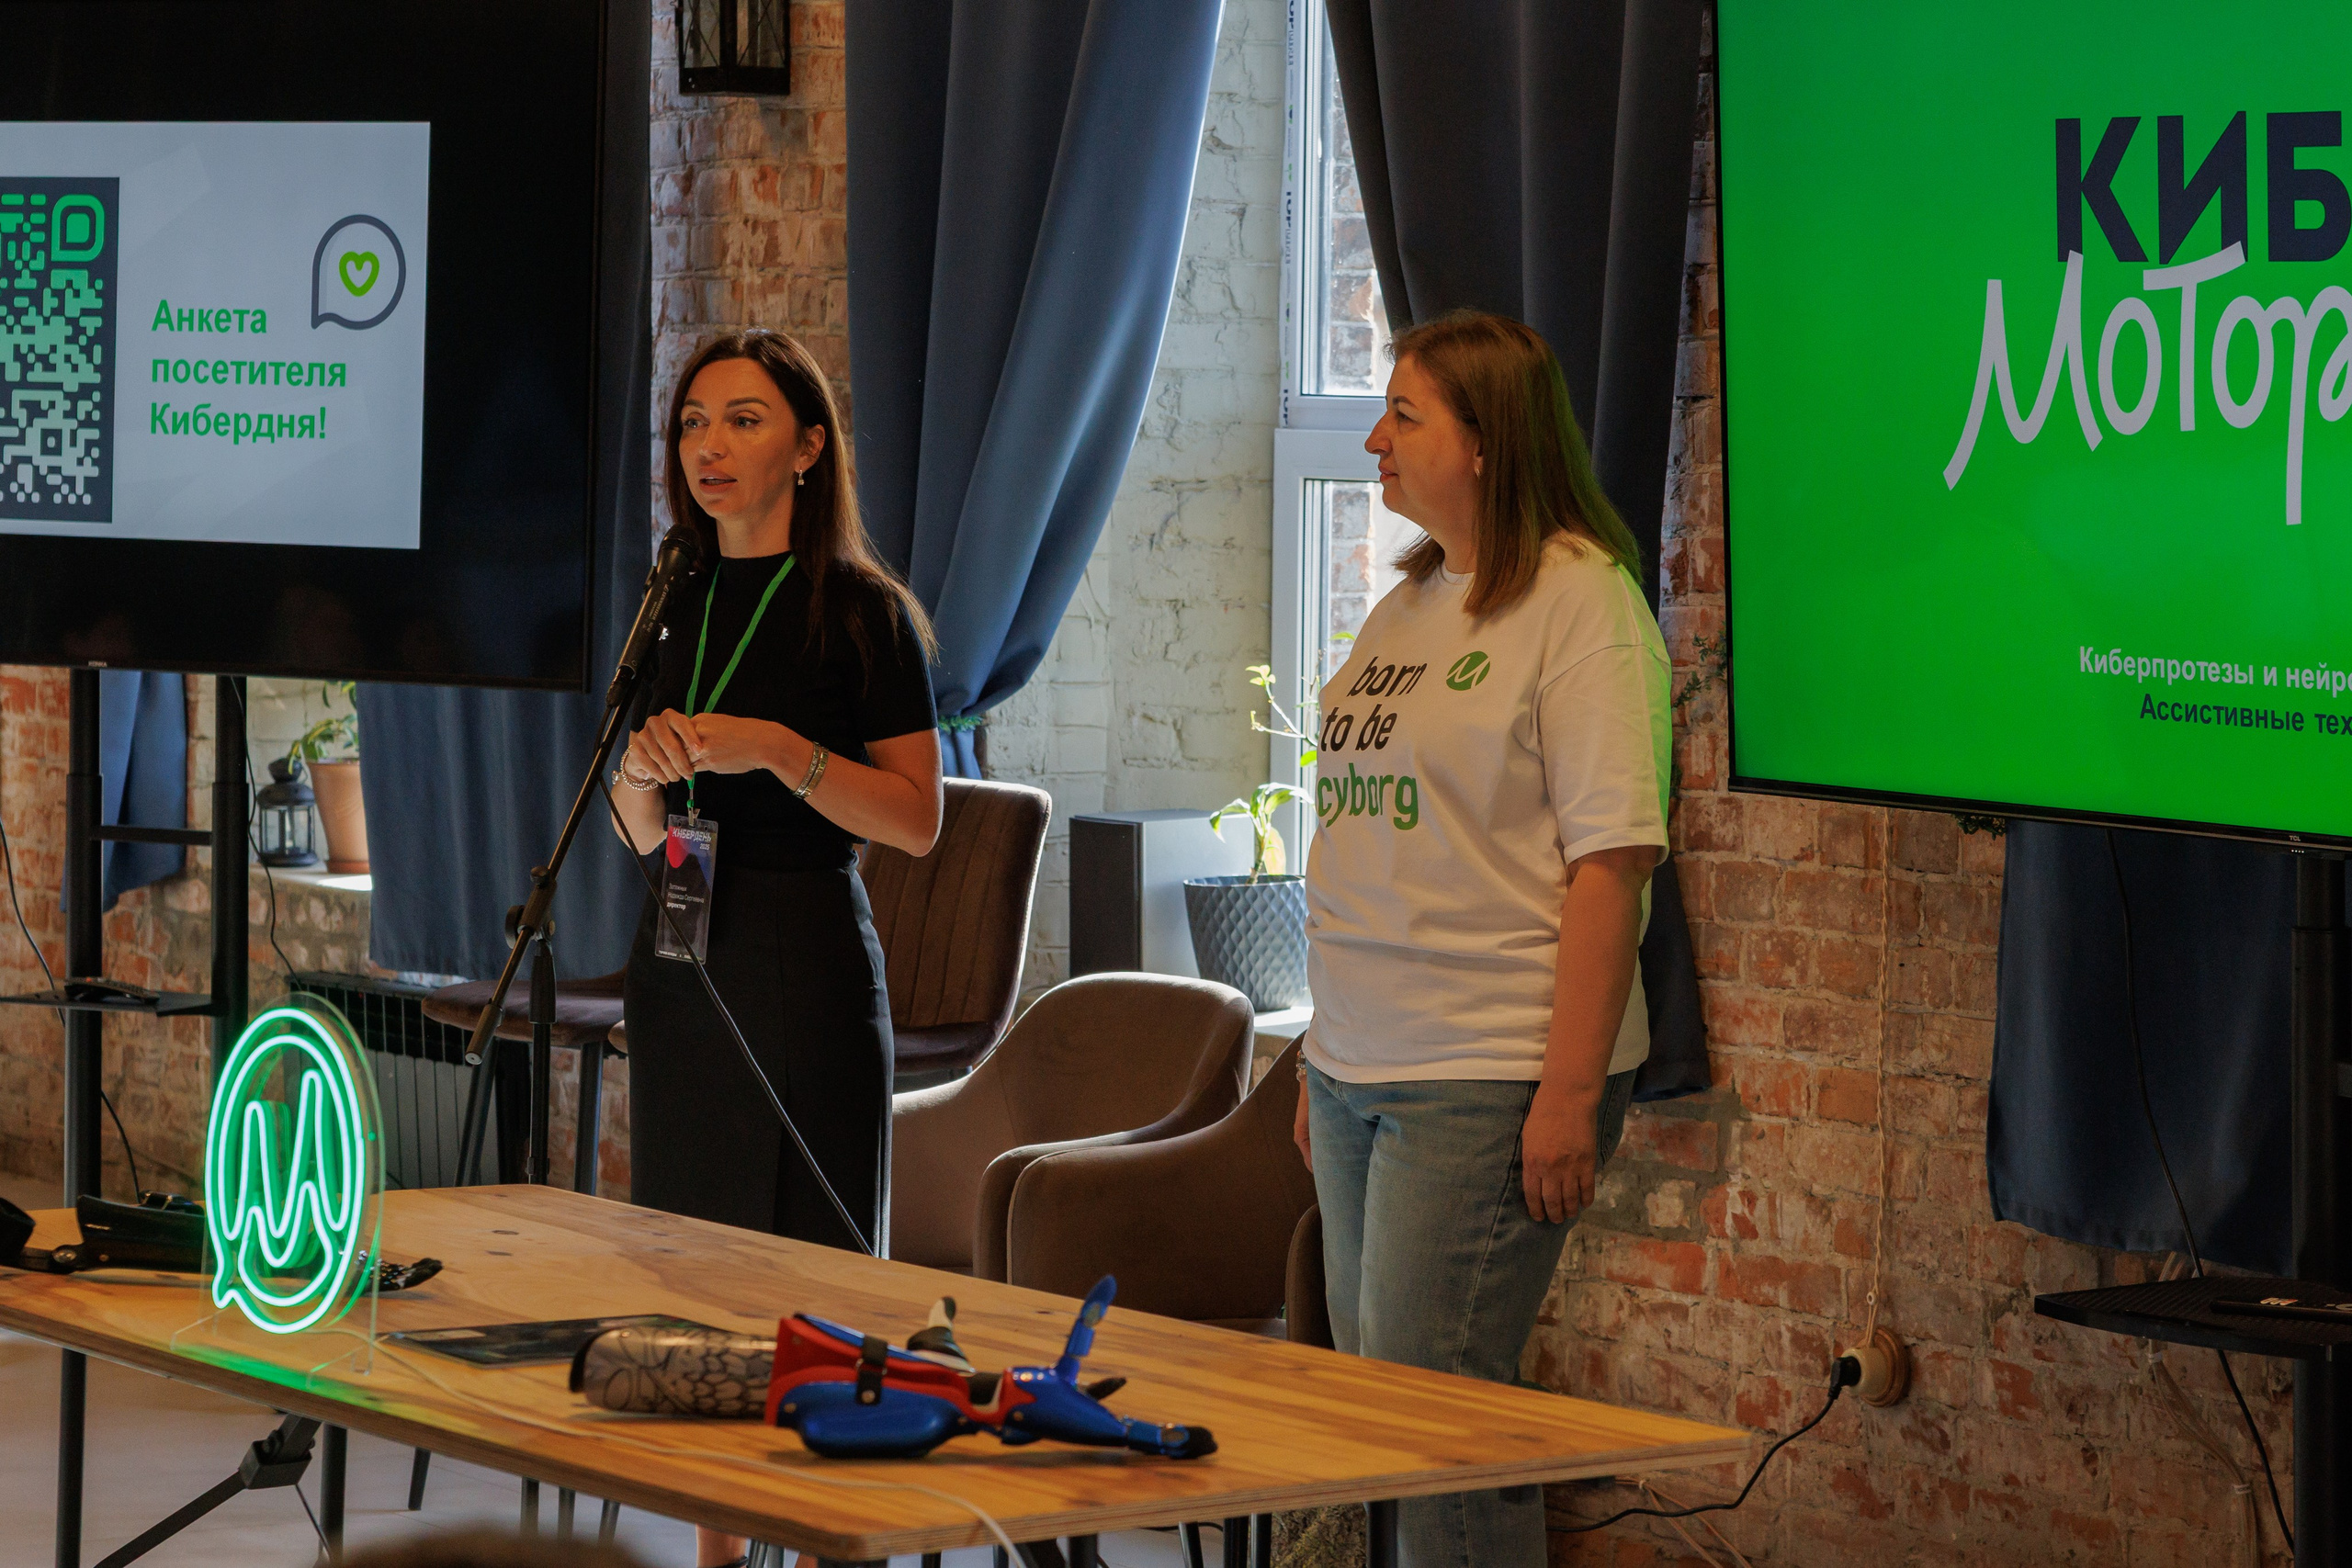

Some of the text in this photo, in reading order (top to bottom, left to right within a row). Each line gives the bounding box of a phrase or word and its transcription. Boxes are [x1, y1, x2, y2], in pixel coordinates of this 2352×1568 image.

[2055, 110, 2352, 265] КИБ
[151, 299, 267, 334] Анкета
[151, 358, 346, 388] посетителя
[150, 401, 326, 446] Кибердня!
[1347, 656, 1427, 696] born
[2079, 646, 2254, 685] Киберпротезы
[2263, 666, 2278, 686] и
[1320, 704, 1397, 751] to be
[2140, 694, 2352, 736] Ассистивные тех
[1317, 762, 1419, 830] cyborg
[672, 828, 712, 842] КИБЕРДЕНЬ
